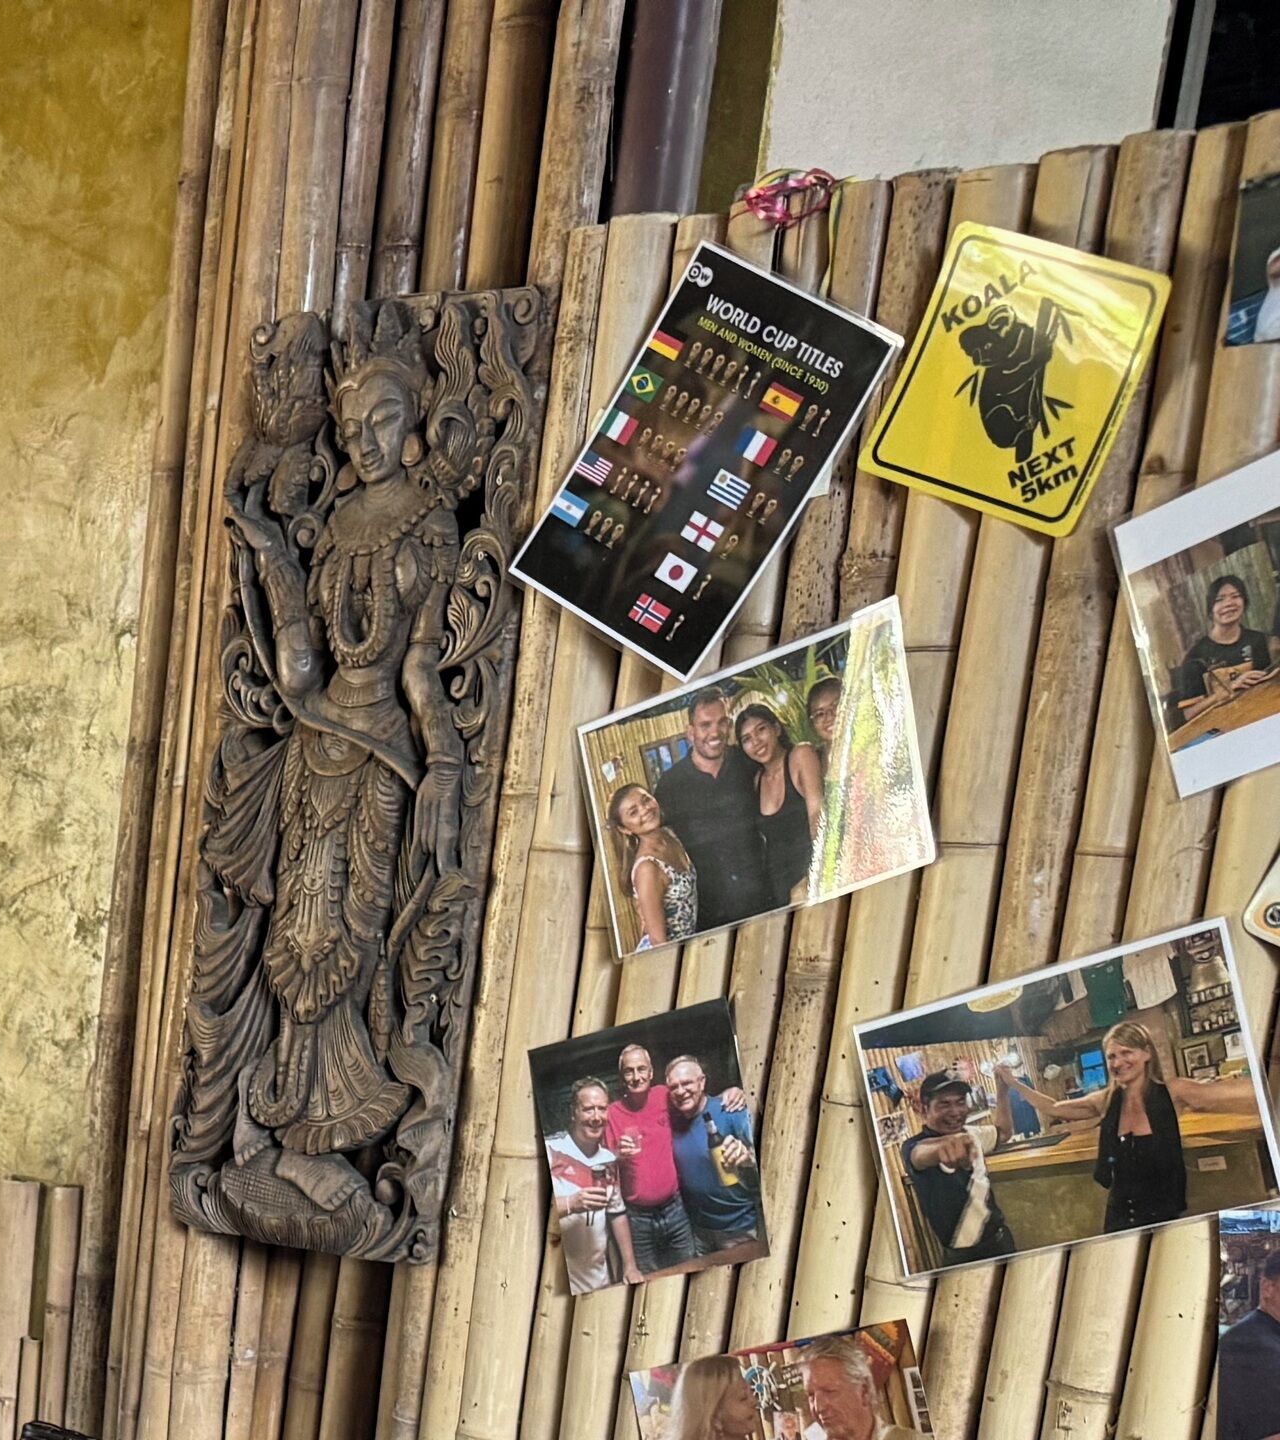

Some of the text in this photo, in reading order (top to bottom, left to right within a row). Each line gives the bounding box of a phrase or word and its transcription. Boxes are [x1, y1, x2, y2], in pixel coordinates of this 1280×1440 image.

[687, 262, 714, 287] DW
[941, 260, 1037, 332] KOALA
[697, 316, 829, 395] MEN AND WOMEN (SINCE 1930)
[706, 293, 844, 378] WORLD CUP TITLES
[1007, 436, 1076, 488] NEXT
[1020, 463, 1078, 503] 5km
